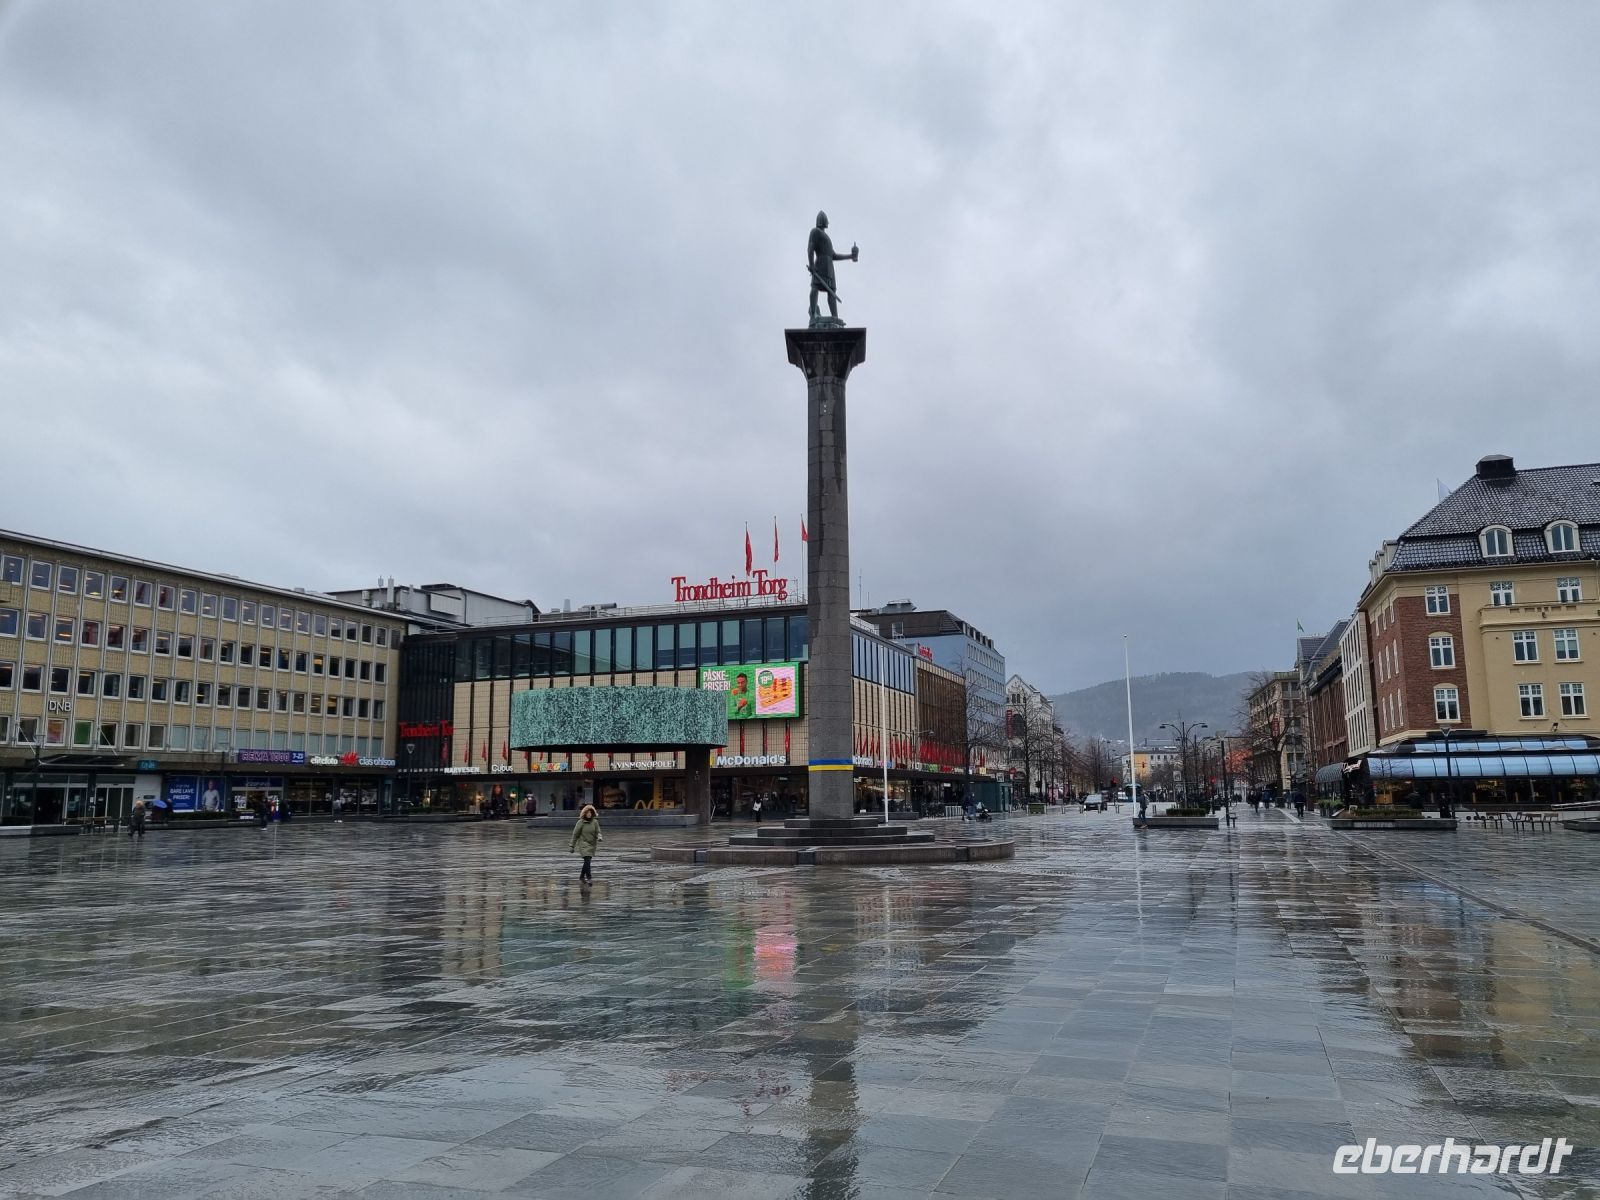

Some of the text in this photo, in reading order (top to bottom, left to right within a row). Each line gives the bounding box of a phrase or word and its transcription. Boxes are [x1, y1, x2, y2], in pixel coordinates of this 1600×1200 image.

[671, 570, 788, 602] Trondheim Torg
[703, 669, 729, 681] PÅSKE-
[703, 681, 731, 691] PRISER!
[49, 698, 72, 715] DNB
[242, 751, 290, 762] REMA 1000
[716, 754, 787, 766] McDonald's
[359, 757, 396, 767] clas ohlson
[616, 760, 677, 769] VINMONOPOLET
[444, 766, 481, 774] NARVESEN
[491, 763, 514, 772] Cubus
